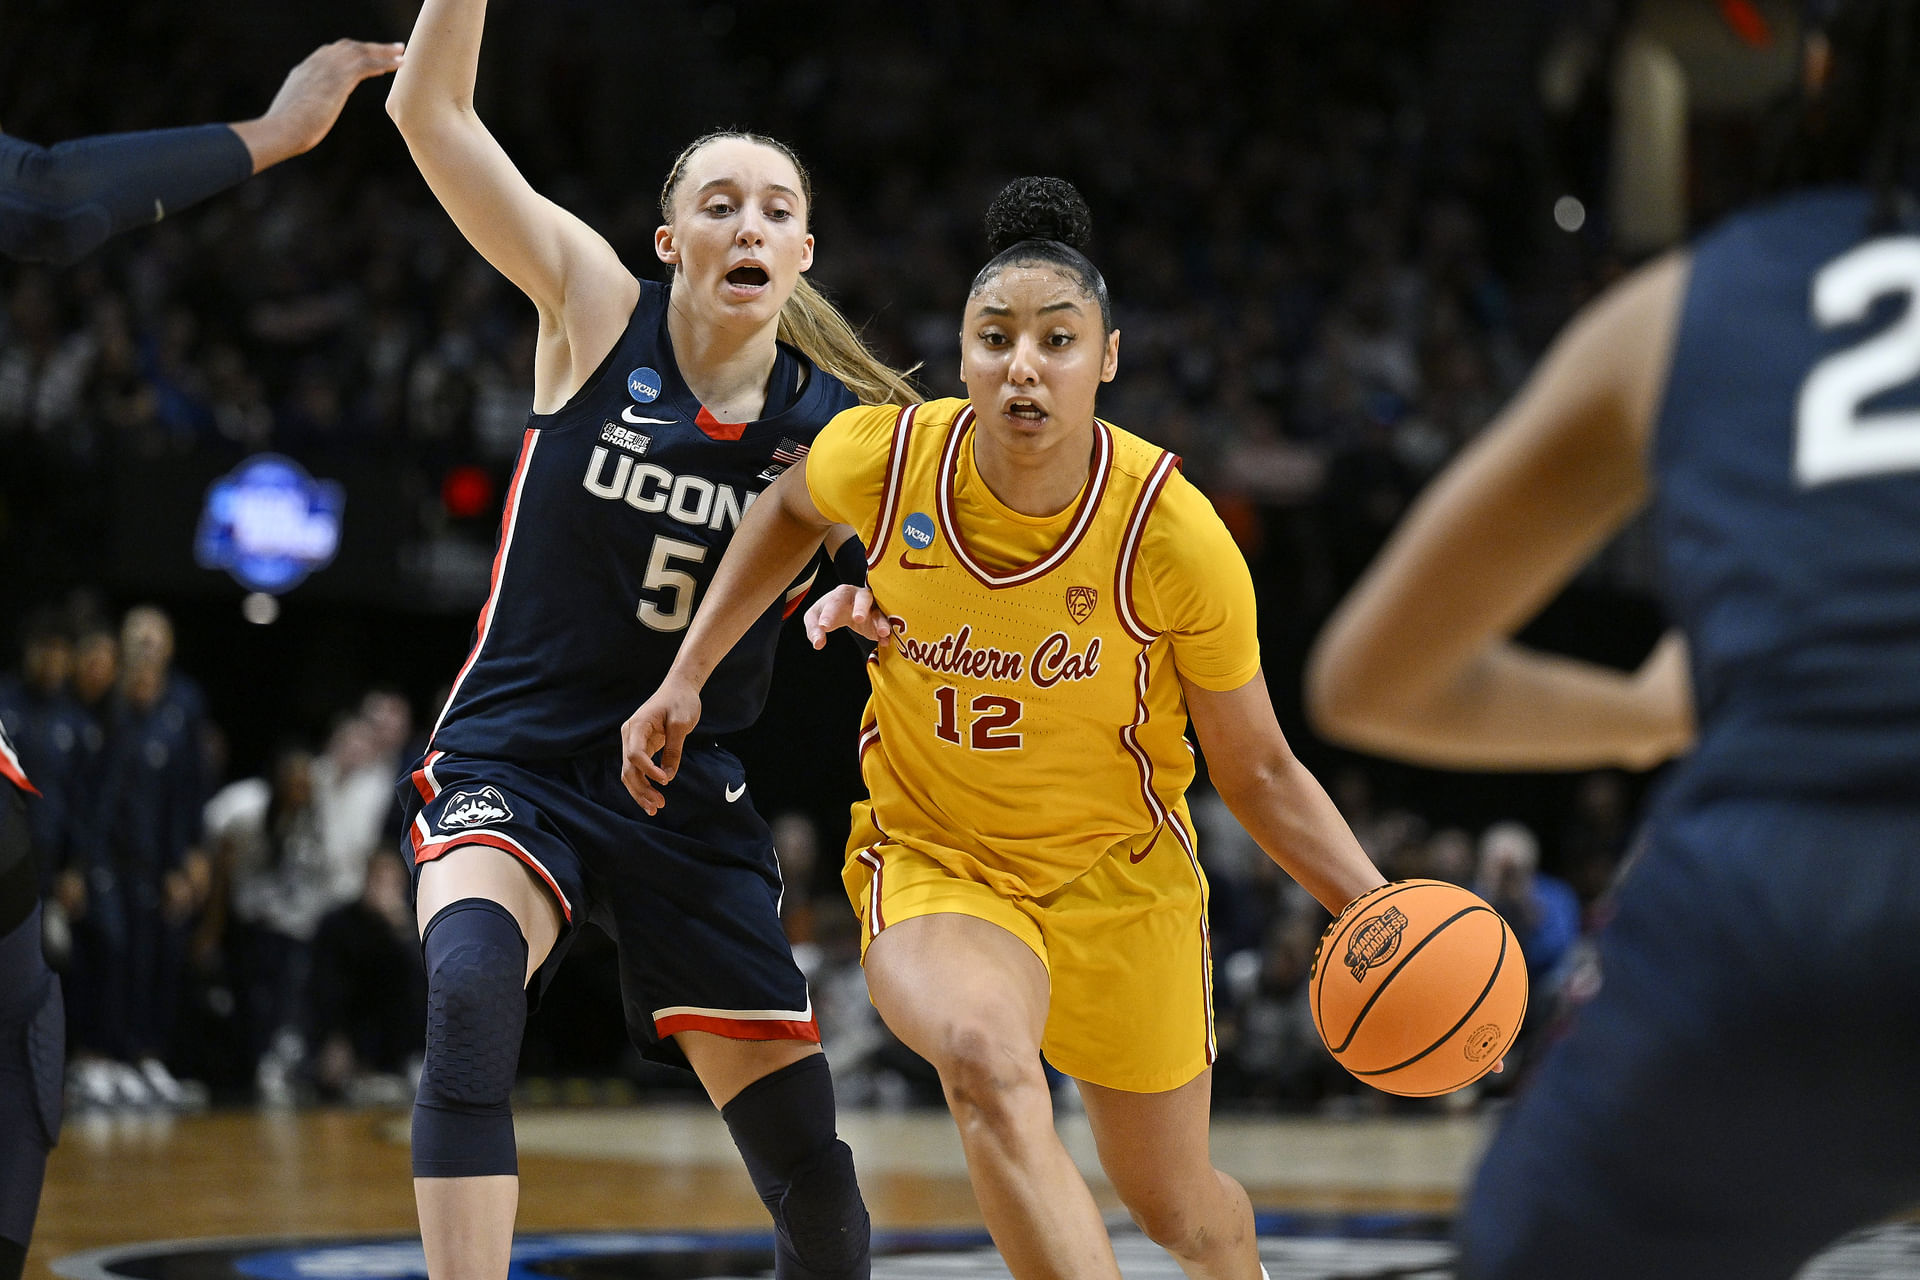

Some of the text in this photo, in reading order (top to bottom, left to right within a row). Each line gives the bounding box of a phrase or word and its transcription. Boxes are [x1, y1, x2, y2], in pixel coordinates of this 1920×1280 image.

[631, 379, 658, 399] NCAA
[601, 432, 648, 454] CHANGE
[904, 525, 930, 545] NCAA
[636, 534, 708, 632] 5
[1073, 603, 1087, 616] 12
[889, 615, 1102, 688] Southern Cal
[934, 685, 1023, 751] 12
[1351, 920, 1385, 957] MARCH
[1362, 914, 1408, 961] MADNESS
